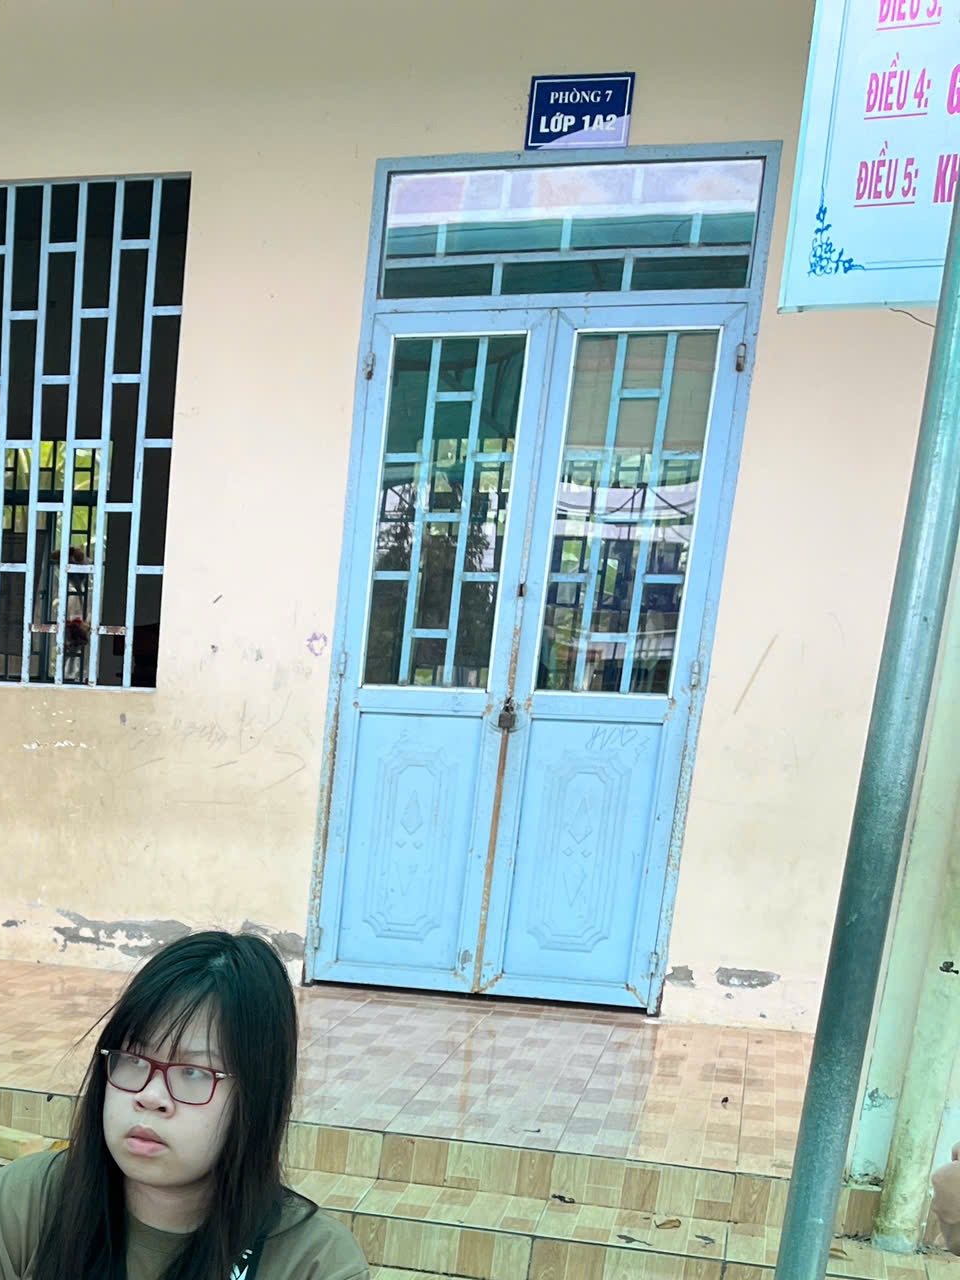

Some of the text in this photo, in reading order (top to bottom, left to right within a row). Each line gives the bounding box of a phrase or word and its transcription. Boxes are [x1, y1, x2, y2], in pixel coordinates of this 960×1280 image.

[549, 87, 614, 104] PHÒNG 7
[865, 51, 911, 113] ĐIỀU
[913, 67, 932, 109] 4:
[539, 111, 618, 133] LỚP 1A2
[855, 139, 900, 201] ĐIỀU
[901, 157, 919, 198] 5:
